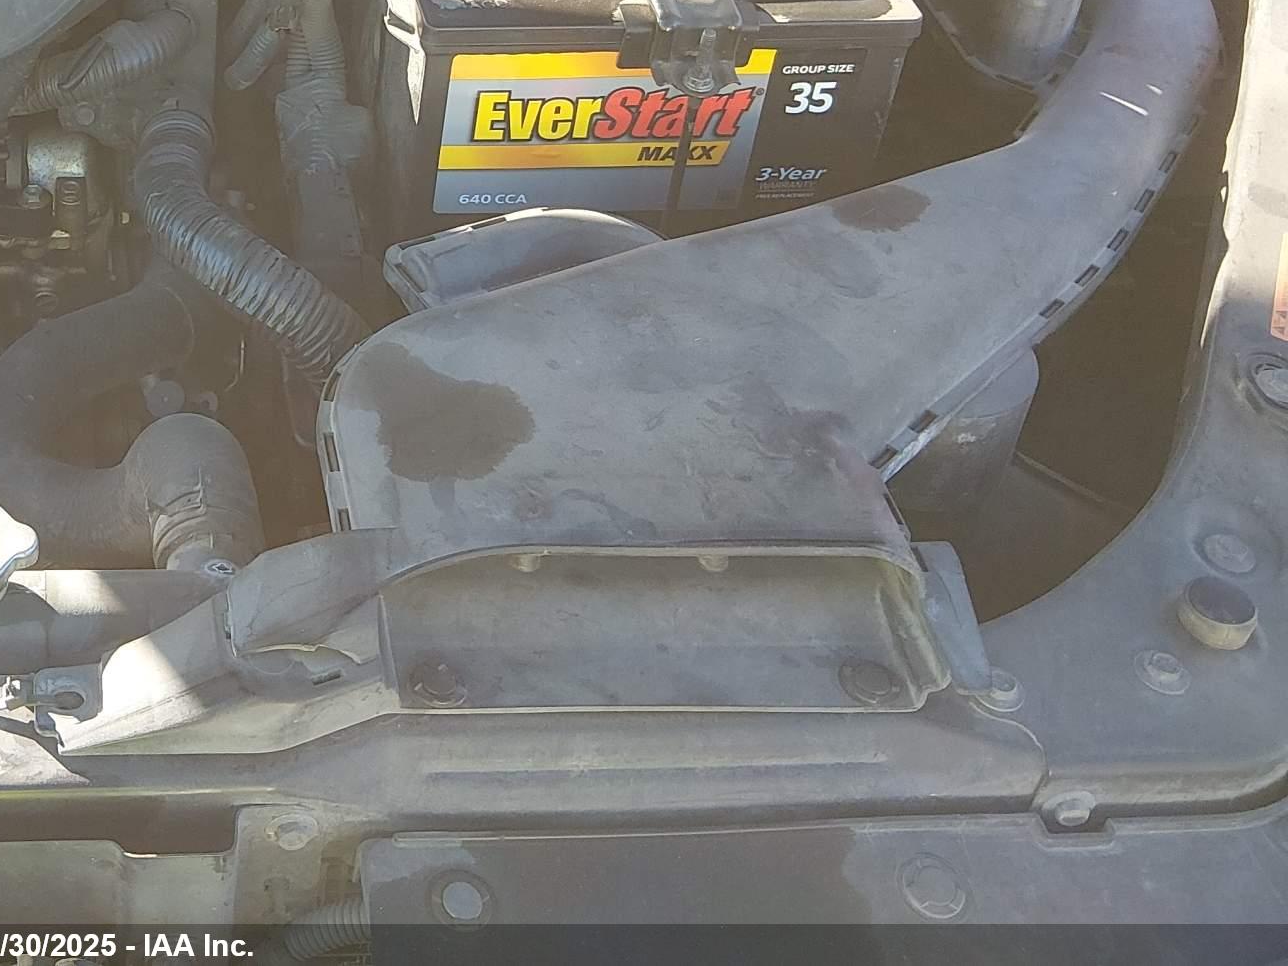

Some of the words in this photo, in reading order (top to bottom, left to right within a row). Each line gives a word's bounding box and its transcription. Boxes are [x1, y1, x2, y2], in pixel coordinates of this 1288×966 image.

[782, 65, 826, 75] GROUP
[827, 64, 855, 74] SIZE
[784, 81, 837, 115] 35
[637, 145, 718, 162] MAXX
[755, 166, 827, 182] 3-Year
[458, 193, 492, 205] 640
[494, 193, 527, 205] CCA
